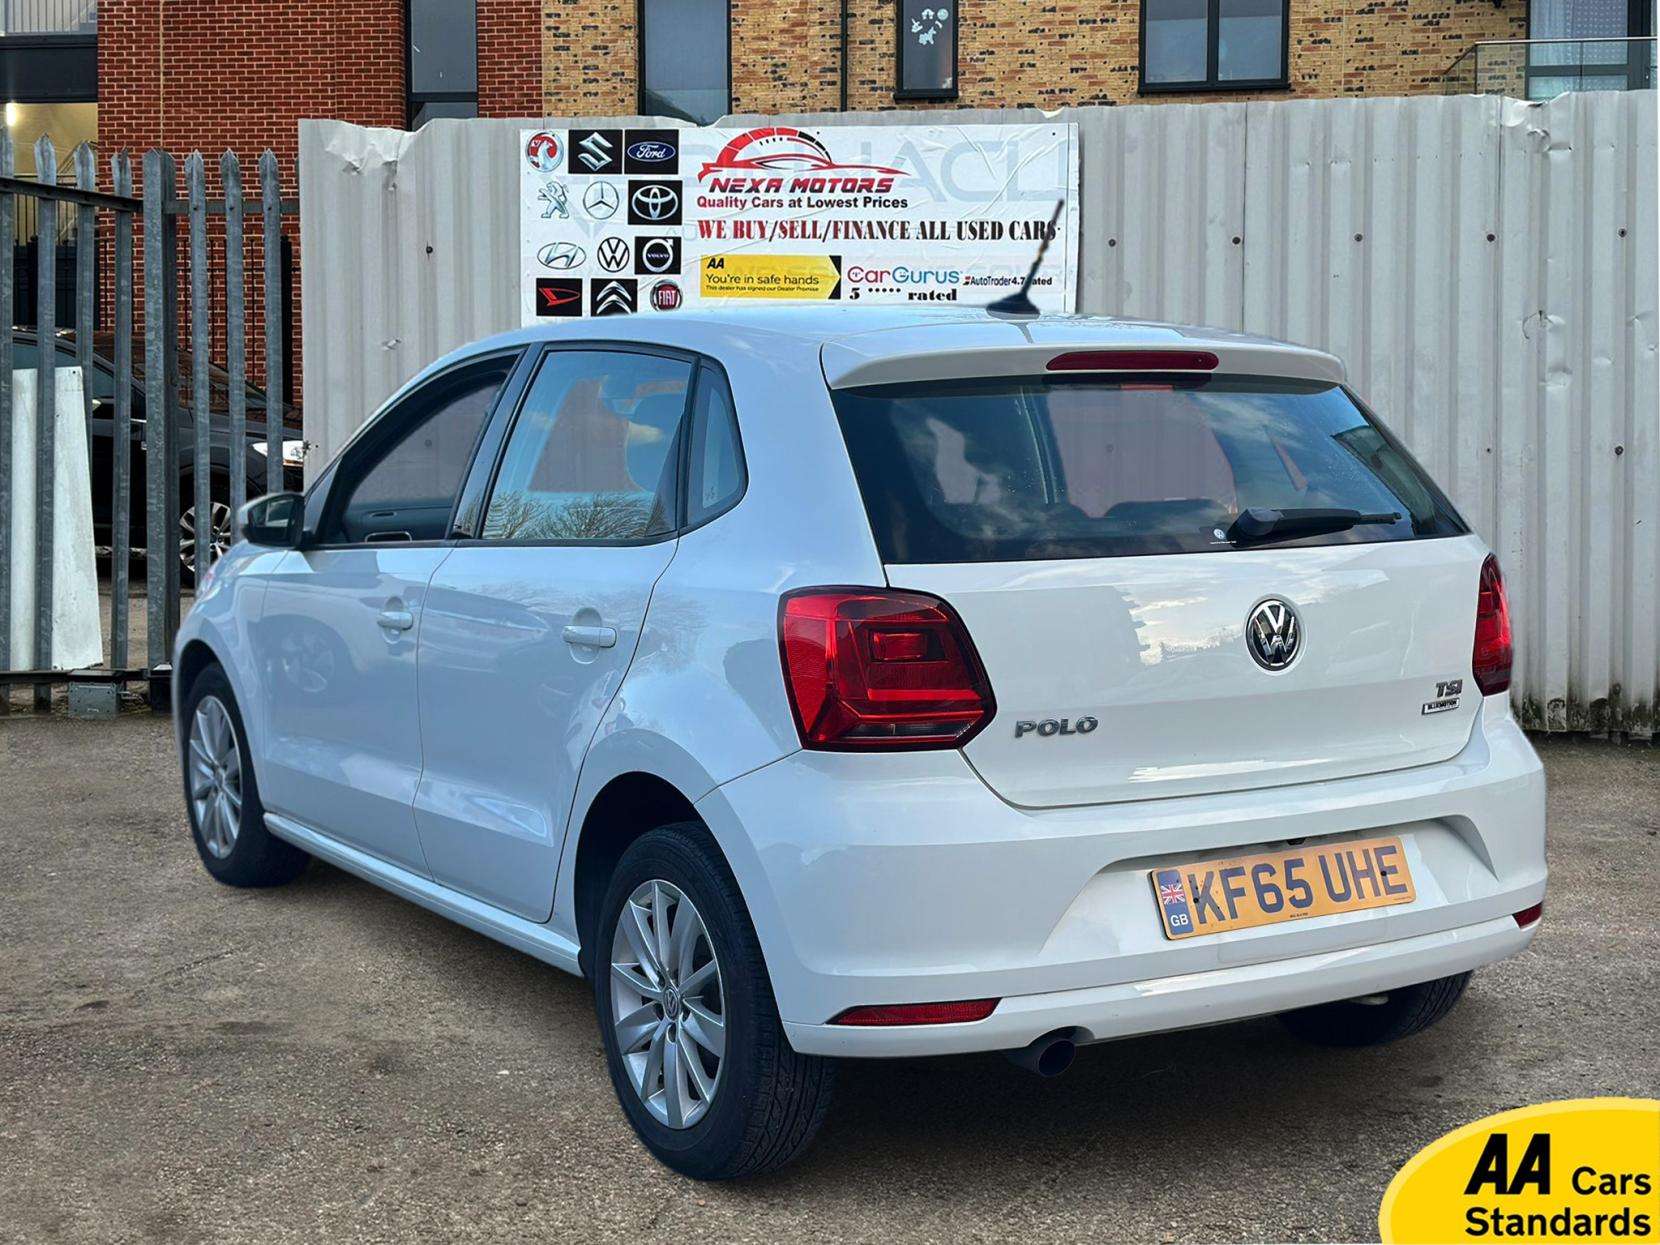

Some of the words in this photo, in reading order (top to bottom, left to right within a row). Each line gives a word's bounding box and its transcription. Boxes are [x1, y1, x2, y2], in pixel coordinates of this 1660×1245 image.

[637, 144, 666, 158] Ford
[709, 178, 783, 193] NEXA
[789, 178, 895, 193] MOTORS
[697, 196, 747, 210] Quality
[751, 196, 784, 208] Cars
[788, 197, 802, 208] at
[807, 196, 859, 208] Lowest
[863, 196, 908, 209] Prices
[697, 220, 726, 239] WE
[732, 220, 911, 242] BUY/SELL/FINANCE
[916, 221, 950, 240] ALL
[957, 221, 1004, 240] USED
[707, 257, 725, 269] AA
[706, 273, 741, 284] You're
[744, 275, 754, 284] in
[757, 274, 781, 284] safe
[784, 275, 820, 285] hands
[847, 266, 960, 284] CarGurus
[1028, 277, 1053, 285] ated
[658, 290, 677, 305] FIAT
[849, 288, 860, 300] 5
[908, 288, 957, 300] rated
[1436, 679, 1463, 697] TSI
[1015, 717, 1098, 739] POLO
[1187, 858, 1313, 924] KF65
[1318, 845, 1407, 903] UHE
[1170, 914, 1189, 927] GB
